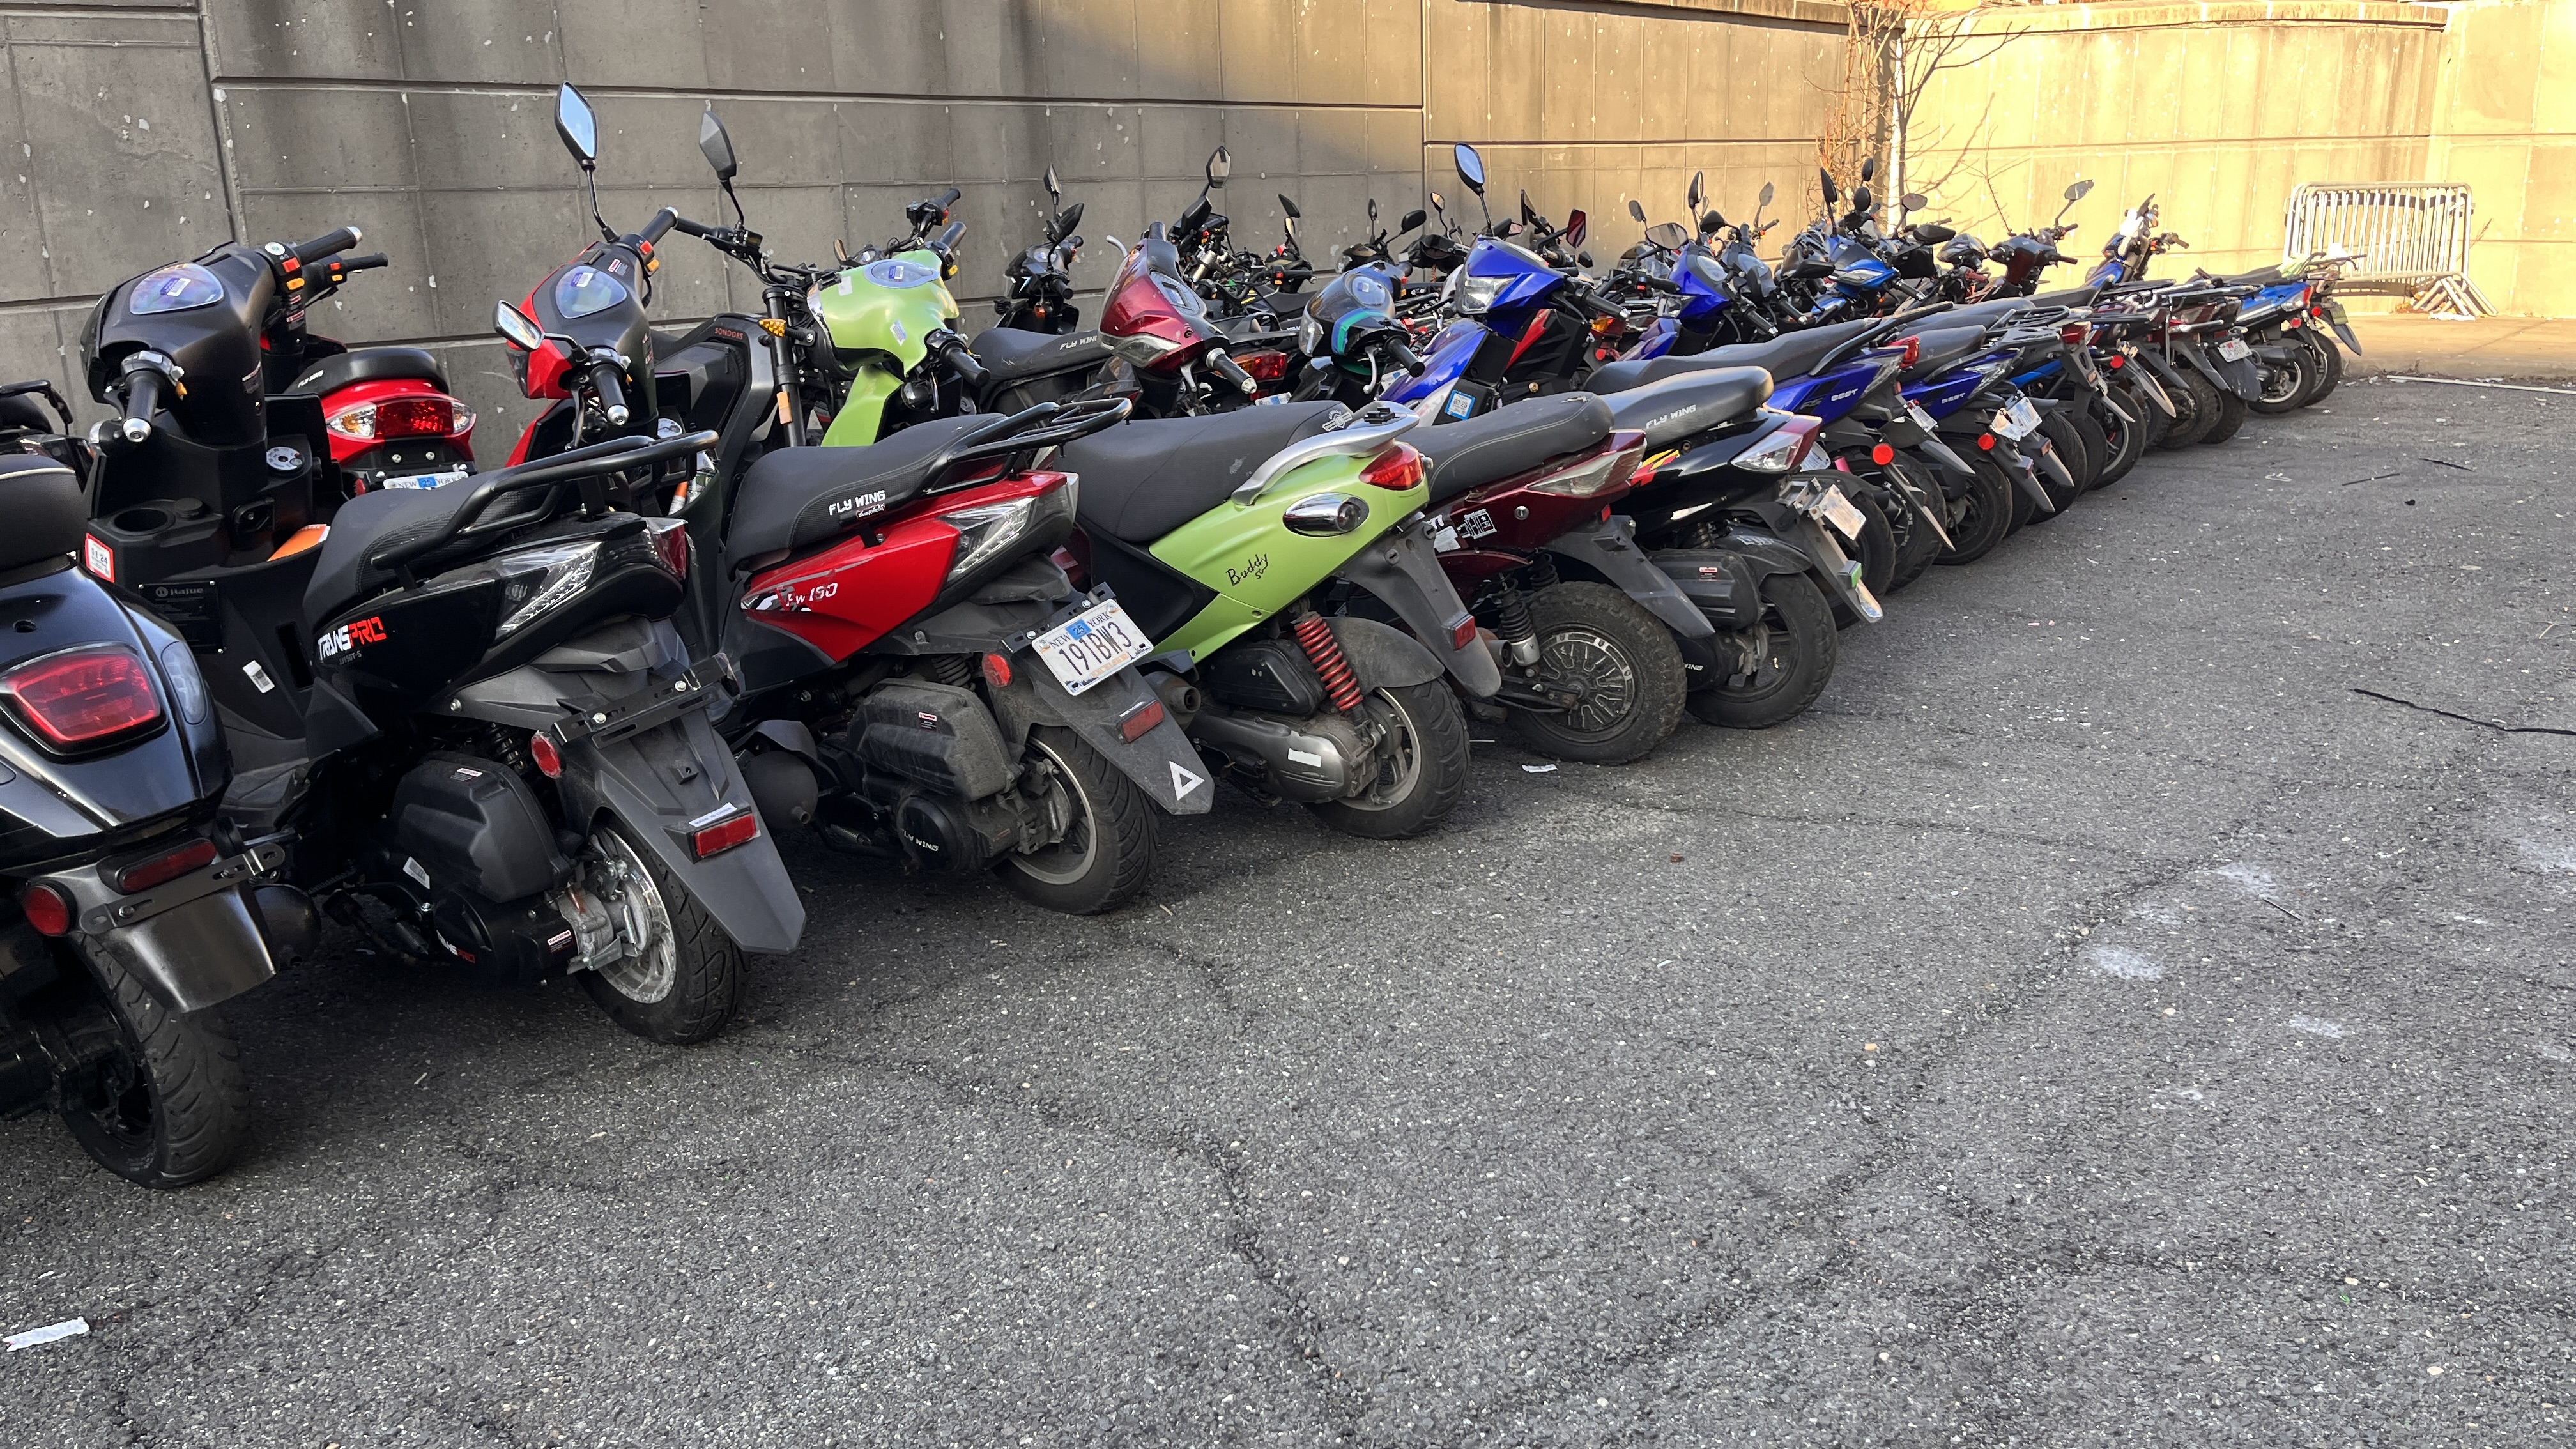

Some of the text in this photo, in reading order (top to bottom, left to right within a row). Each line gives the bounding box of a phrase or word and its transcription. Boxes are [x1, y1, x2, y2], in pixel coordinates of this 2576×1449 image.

[715, 327, 744, 340] SONDORS
[1646, 404, 1697, 429] FLY WING
[829, 498, 852, 516] FLY
[855, 489, 886, 508] WING
[1225, 553, 1268, 587] Buddy
[1049, 610, 1113, 650] NEW YORK
[1073, 625, 1085, 636] 25
[1058, 622, 1132, 676] 191BW3
[916, 838, 940, 852] WING
